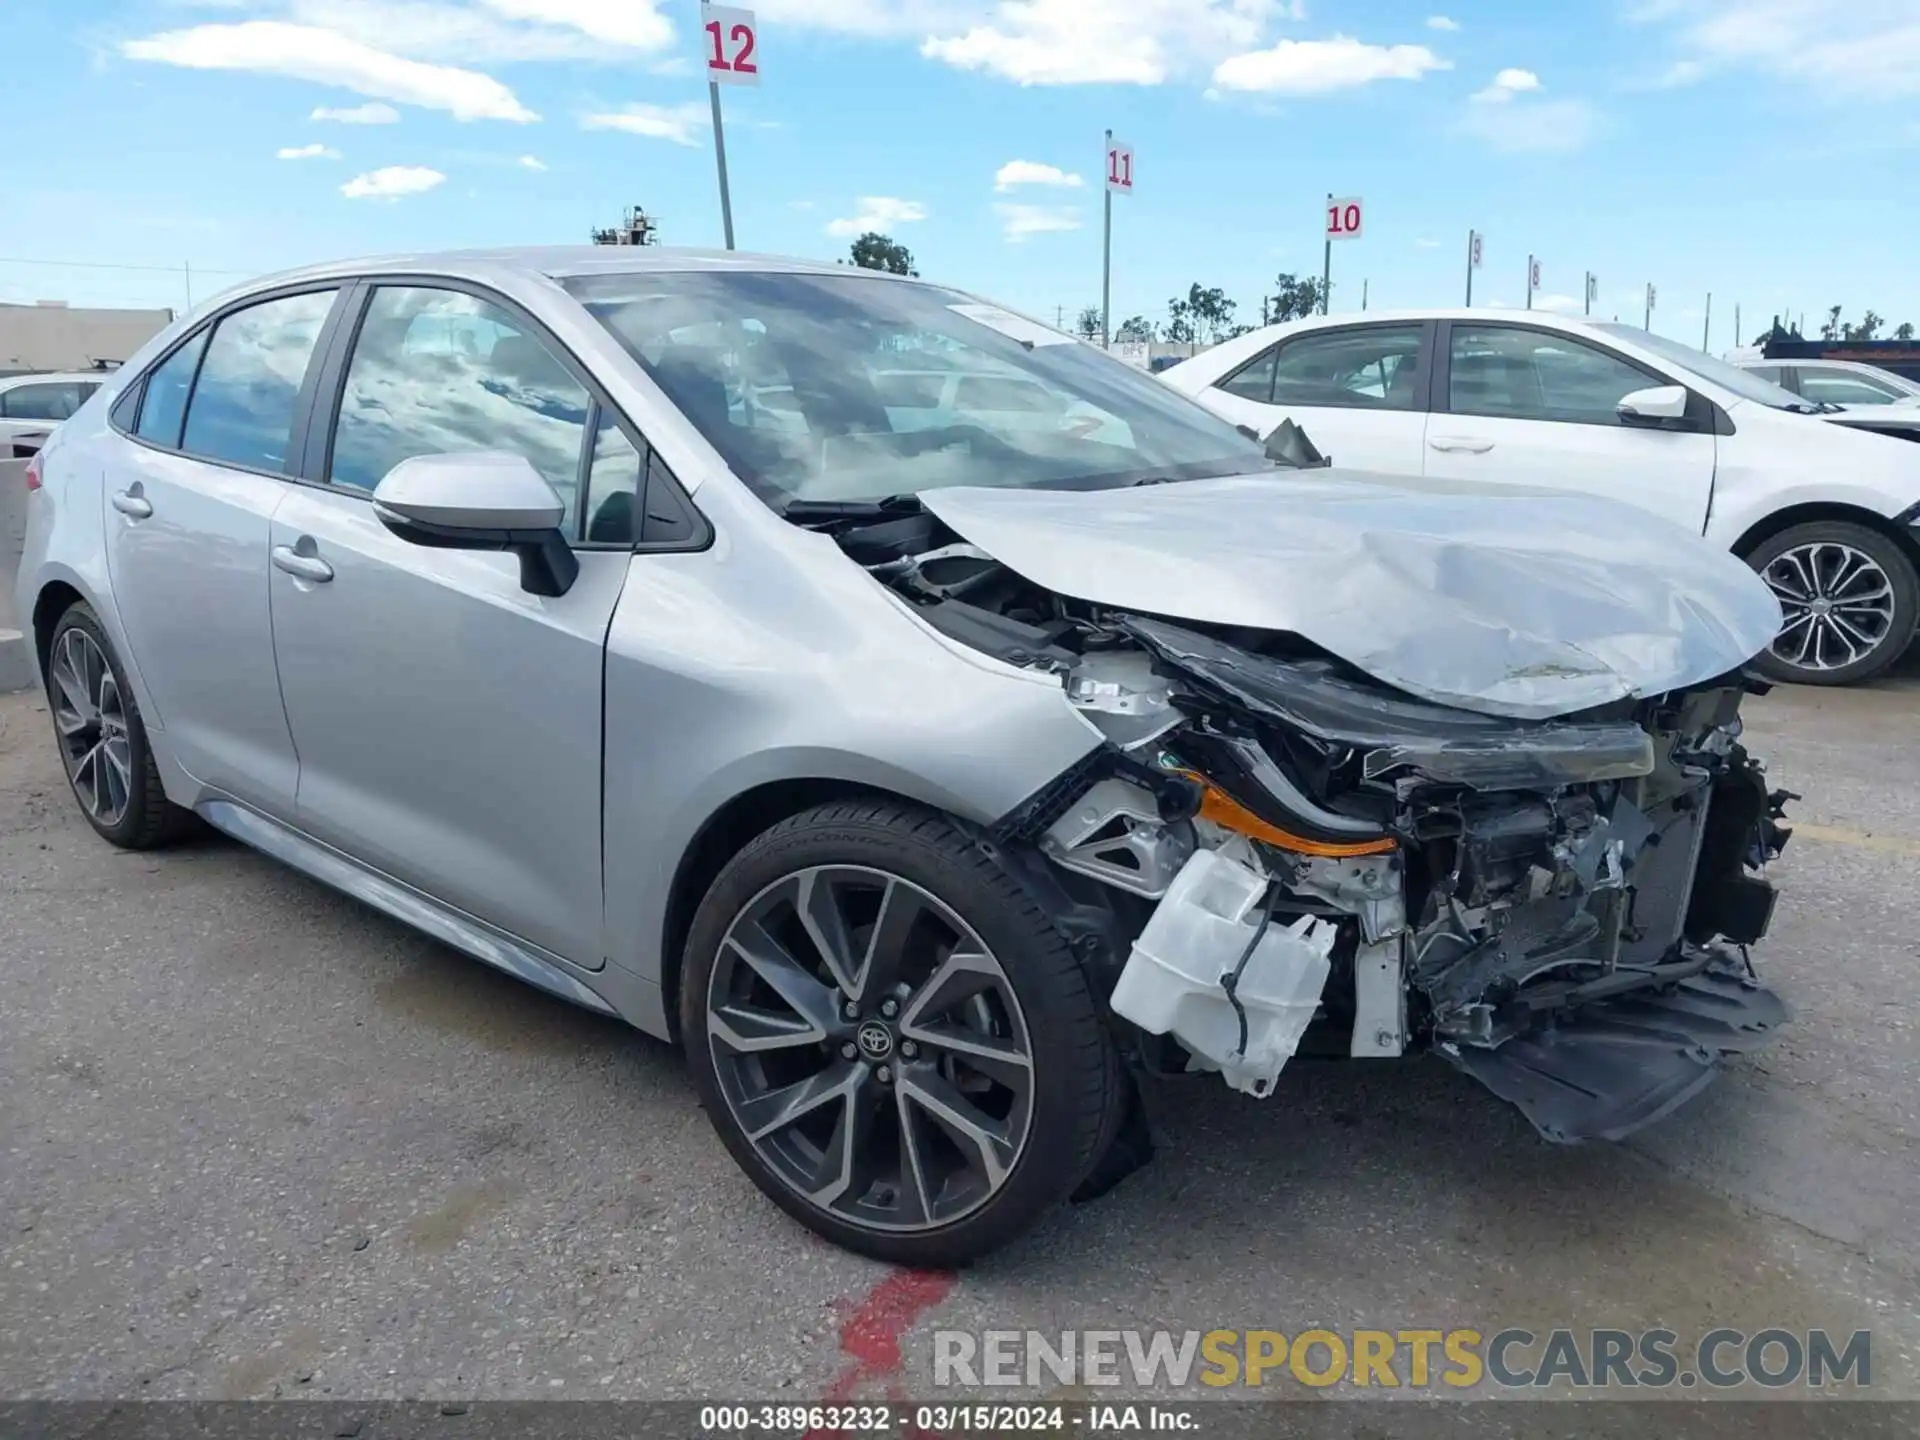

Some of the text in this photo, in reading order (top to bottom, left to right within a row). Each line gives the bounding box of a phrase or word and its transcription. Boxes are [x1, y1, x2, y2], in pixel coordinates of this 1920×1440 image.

[705, 20, 757, 74] 12
[1108, 150, 1132, 187] 11
[1327, 204, 1360, 232] 10
[1473, 238, 1482, 265] 9
[1532, 263, 1541, 286] 8
